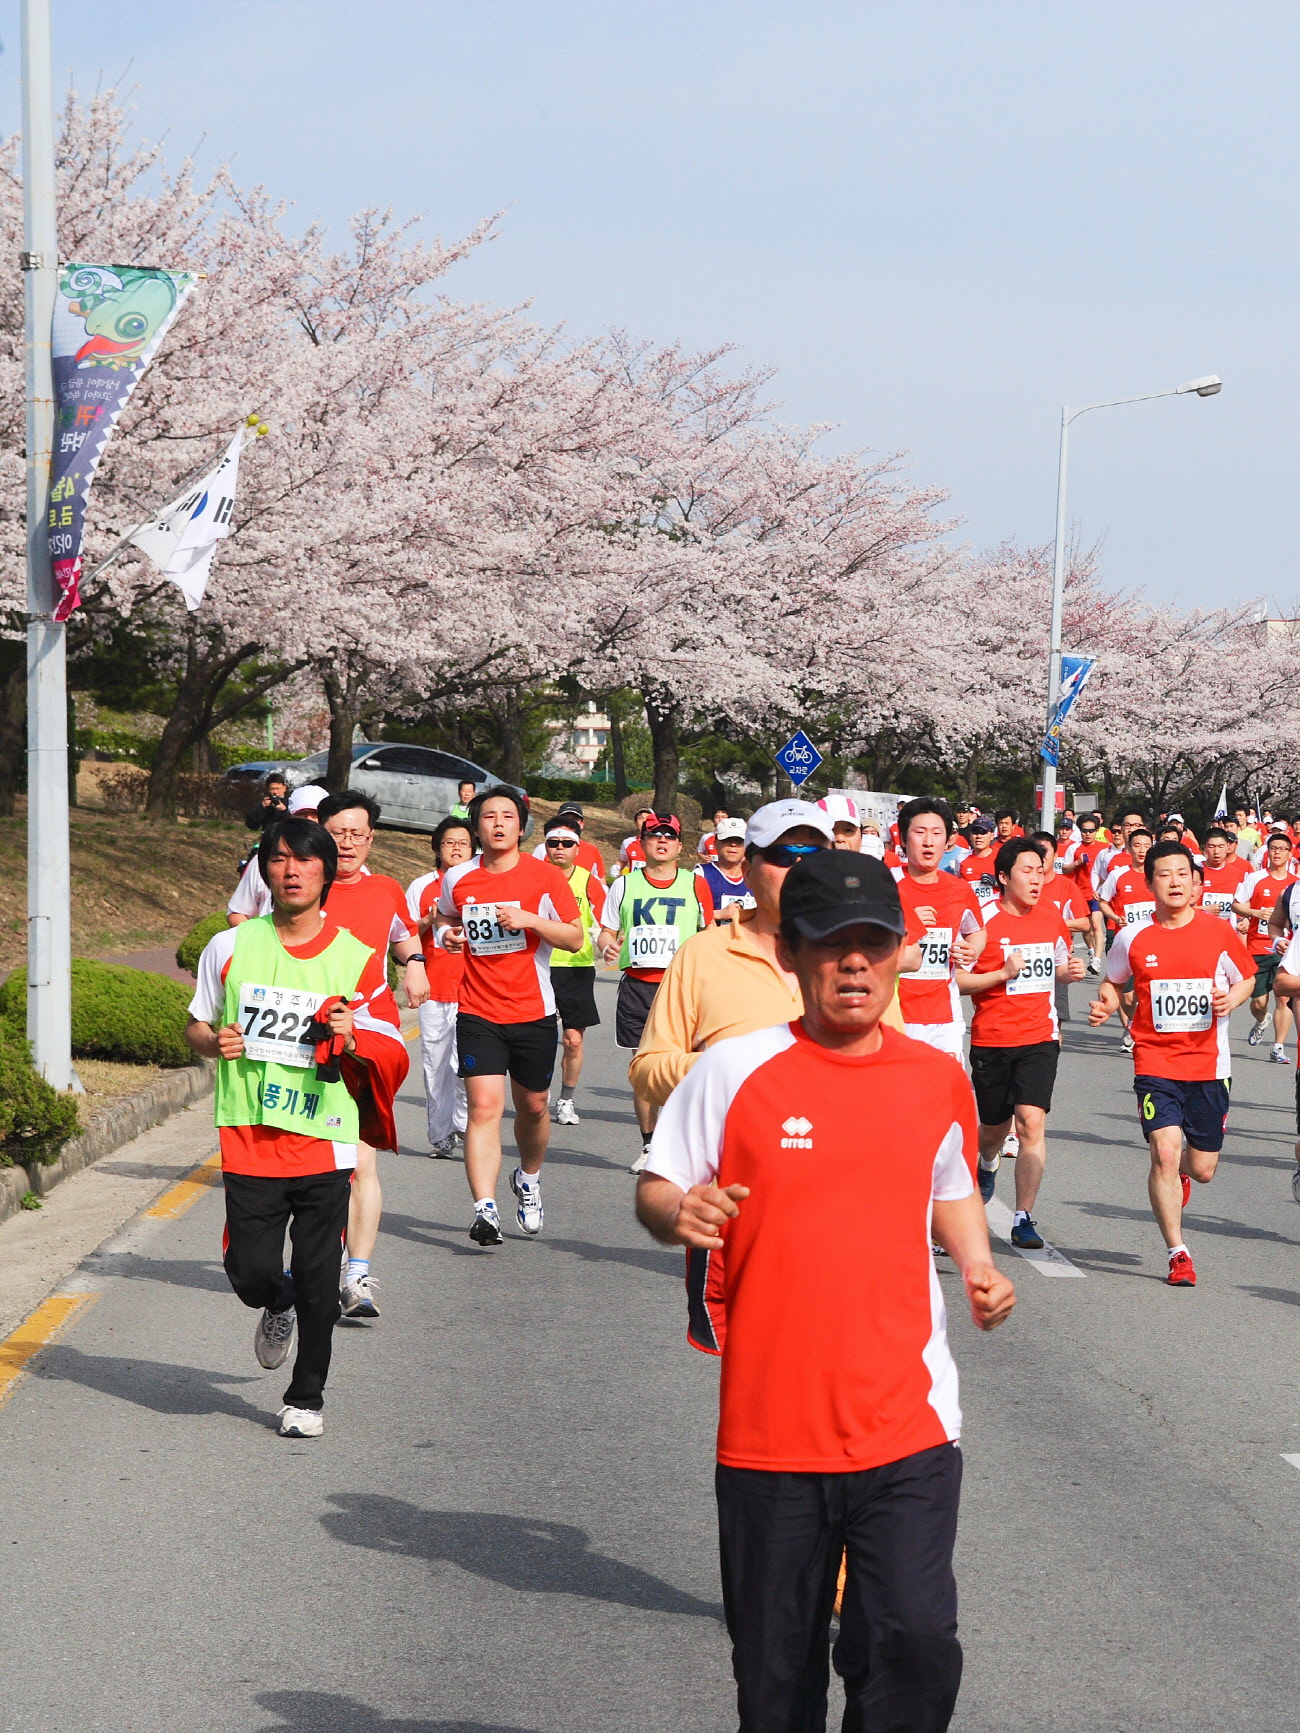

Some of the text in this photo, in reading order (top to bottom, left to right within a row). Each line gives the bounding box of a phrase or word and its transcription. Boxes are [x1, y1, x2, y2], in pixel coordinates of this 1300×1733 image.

[788, 765, 809, 775] 교차로
[632, 896, 687, 928] KT
[632, 937, 677, 956] 10074
[1013, 957, 1054, 980] 569
[1173, 982, 1205, 992] 경주시
[272, 990, 318, 1011] 경주시
[1155, 994, 1209, 1016] 10269
[243, 1005, 317, 1046] 7222
[1143, 1092, 1156, 1120] 6
[780, 1137, 813, 1149] errea
